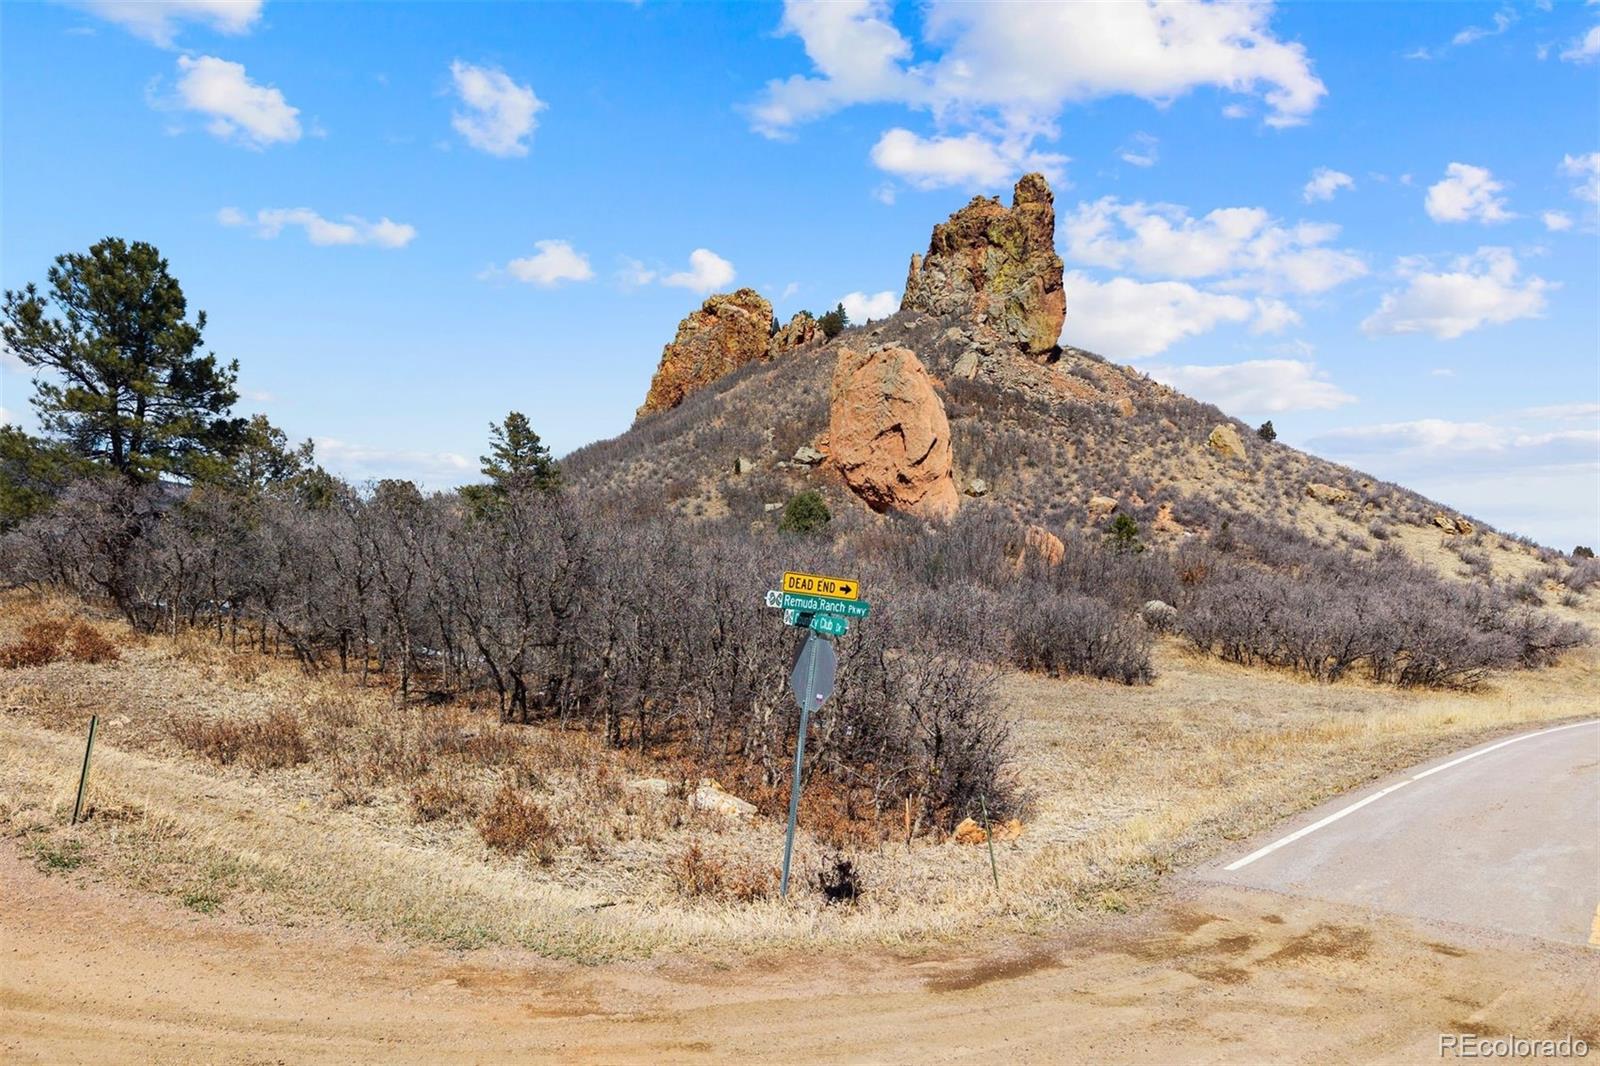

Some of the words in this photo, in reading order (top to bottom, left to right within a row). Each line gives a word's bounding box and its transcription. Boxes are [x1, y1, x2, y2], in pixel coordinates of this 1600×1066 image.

[789, 576, 814, 590] DEAD
[817, 580, 836, 593] END
[784, 595, 818, 610] Remuda
[820, 599, 846, 612] Ranch
[848, 605, 868, 616] Pkwy
